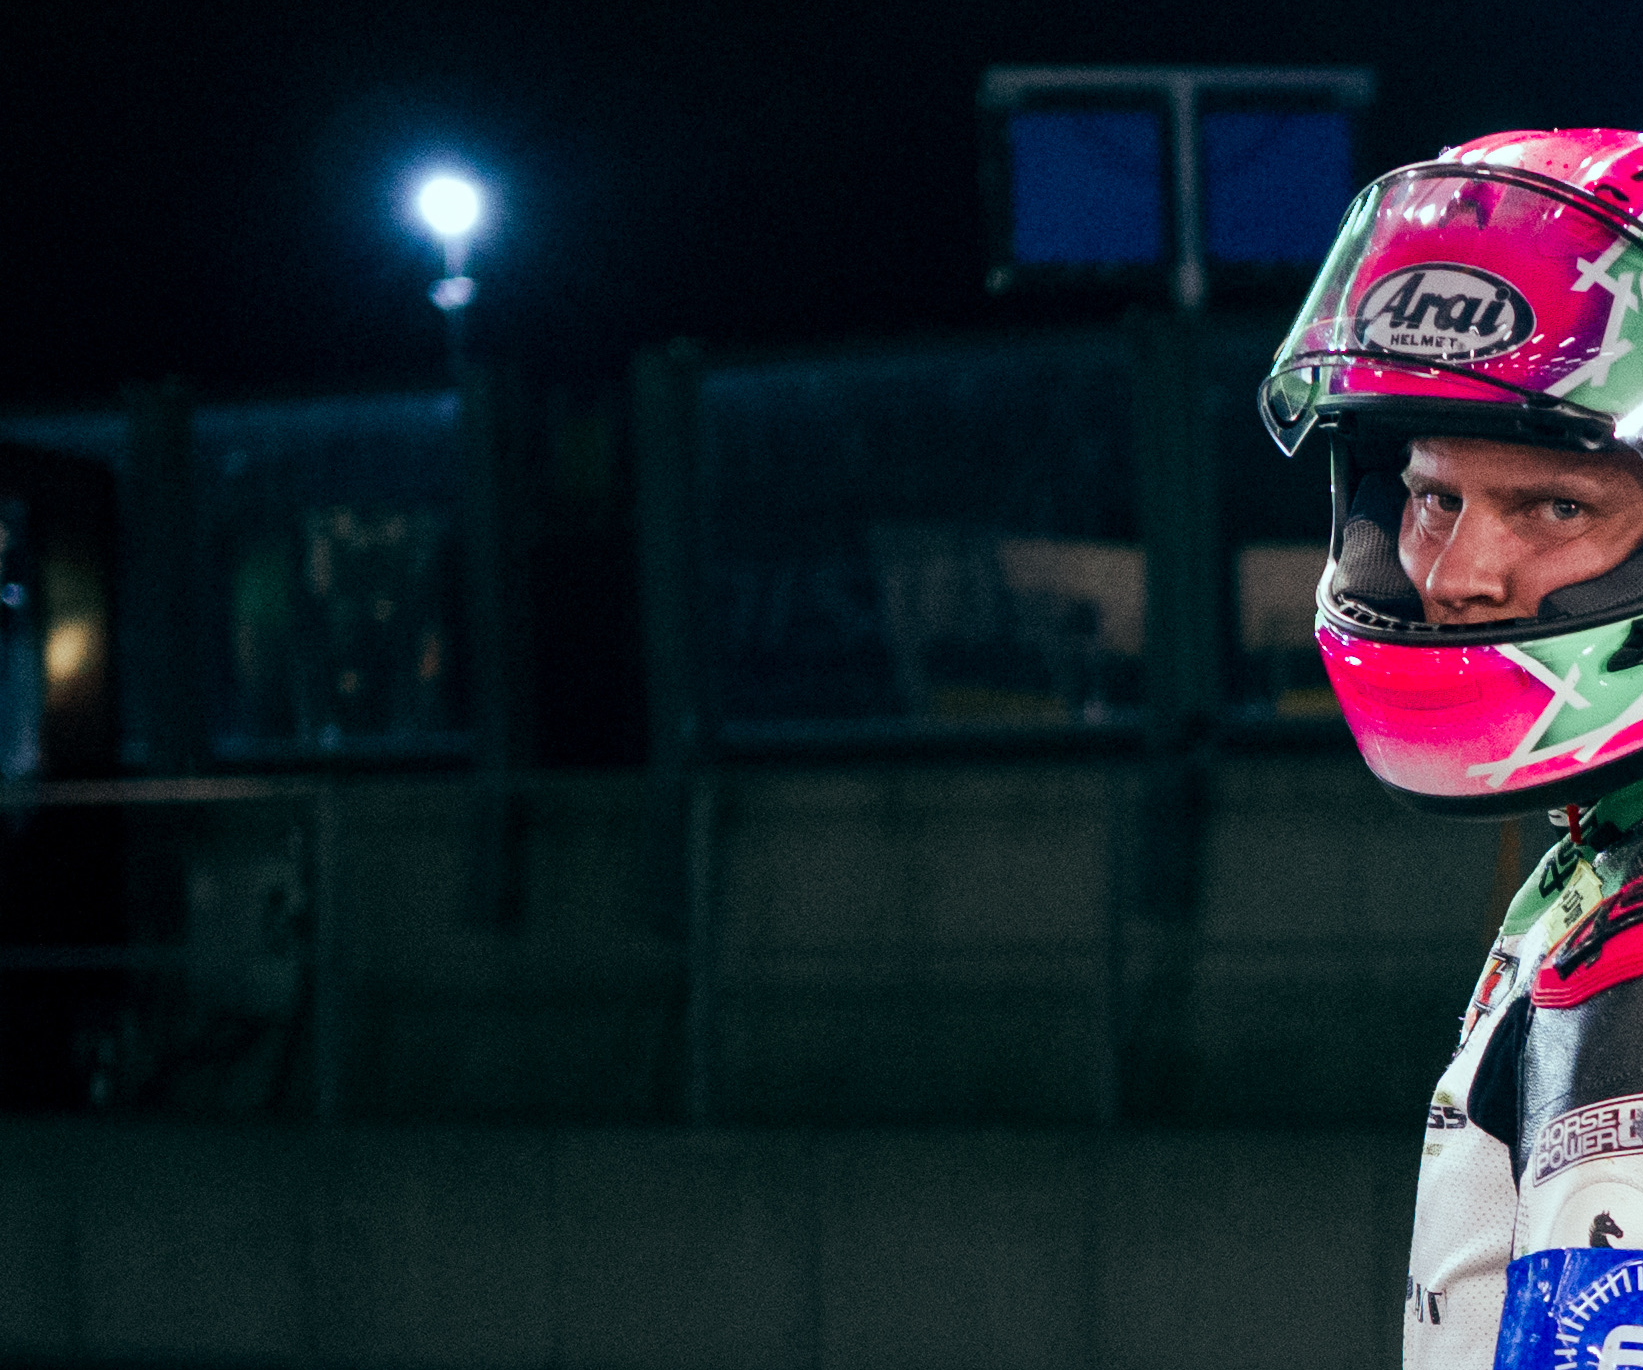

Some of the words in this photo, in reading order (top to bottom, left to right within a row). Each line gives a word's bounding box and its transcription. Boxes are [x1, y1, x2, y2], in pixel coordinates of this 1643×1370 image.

[1369, 272, 1512, 337] Arai
[1390, 333, 1459, 348] HELMET
[1536, 1109, 1617, 1150] HORSE
[1535, 1127, 1619, 1179] POWER
